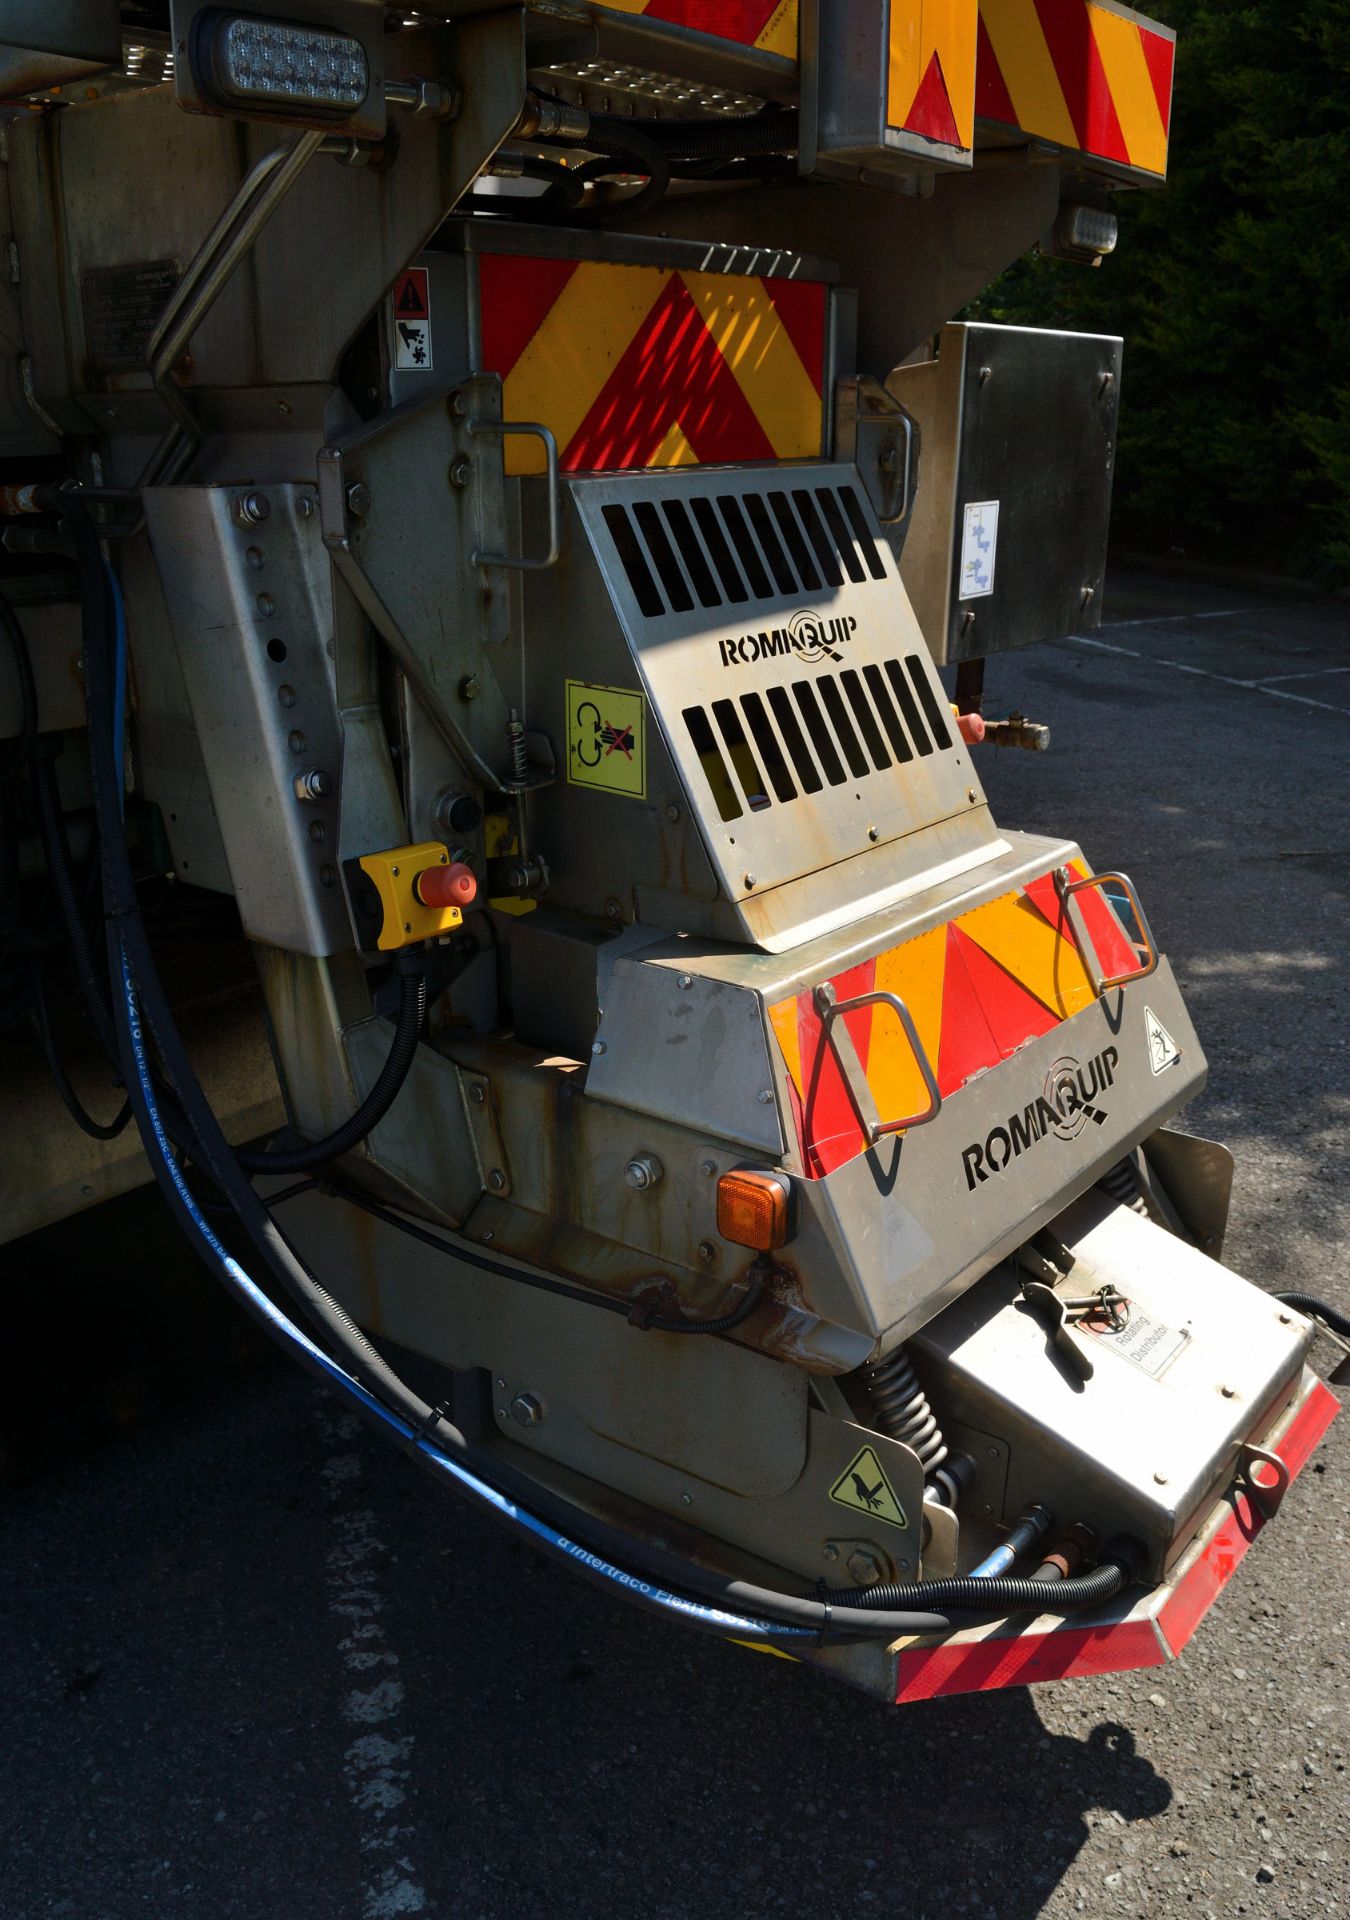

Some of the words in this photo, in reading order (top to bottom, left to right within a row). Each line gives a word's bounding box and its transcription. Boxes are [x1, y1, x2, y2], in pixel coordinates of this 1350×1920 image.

[719, 616, 857, 667] ROMAQUIP
[961, 1045, 1118, 1192] ROMAQUIP
[150, 1107, 159, 1119] EN
[199, 1220, 210, 1233] WP
[1115, 1316, 1151, 1346] Rotating
[1129, 1323, 1169, 1362] Distributor
[570, 1545, 650, 1593] Intertraco
